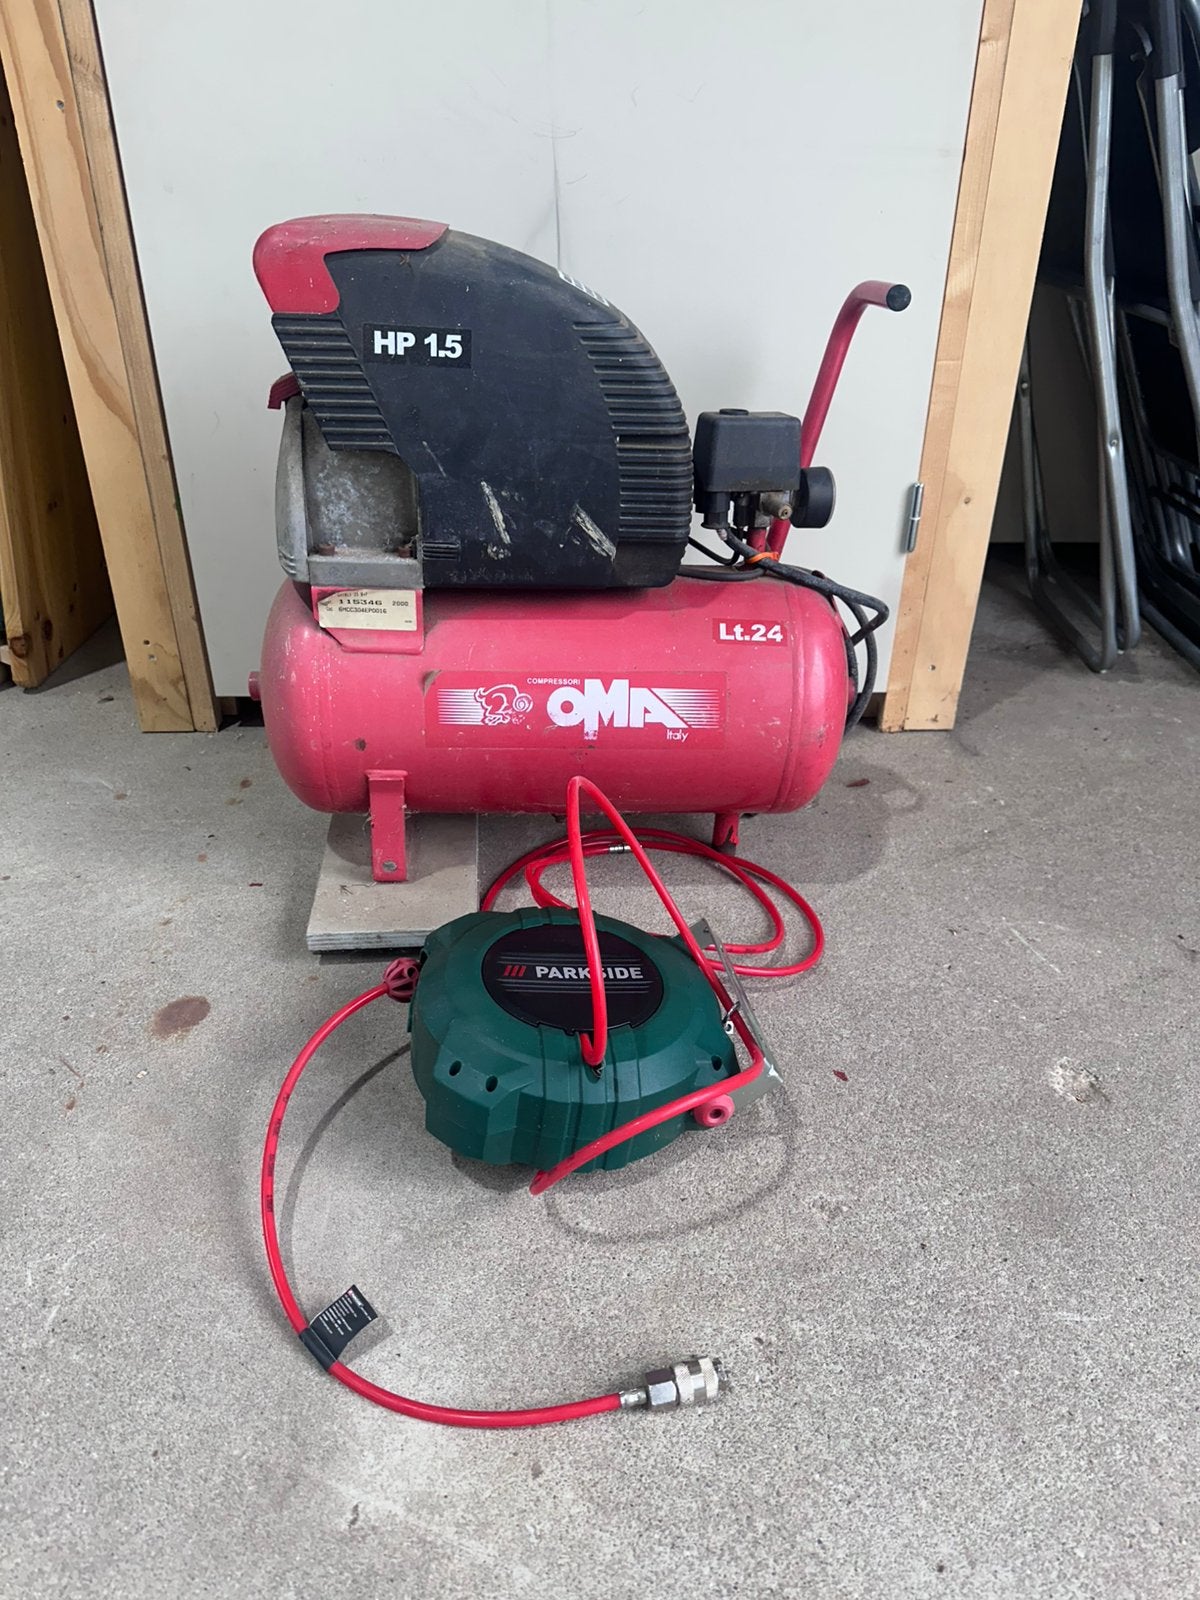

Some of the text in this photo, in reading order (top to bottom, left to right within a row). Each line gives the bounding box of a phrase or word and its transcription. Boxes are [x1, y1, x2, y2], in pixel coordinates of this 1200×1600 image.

[374, 330, 463, 358] HP 1.5
[719, 622, 784, 643] Lt.24
[526, 677, 581, 685] COMPRESSORI
[547, 679, 690, 740] OMA
[666, 728, 689, 742] Italy
